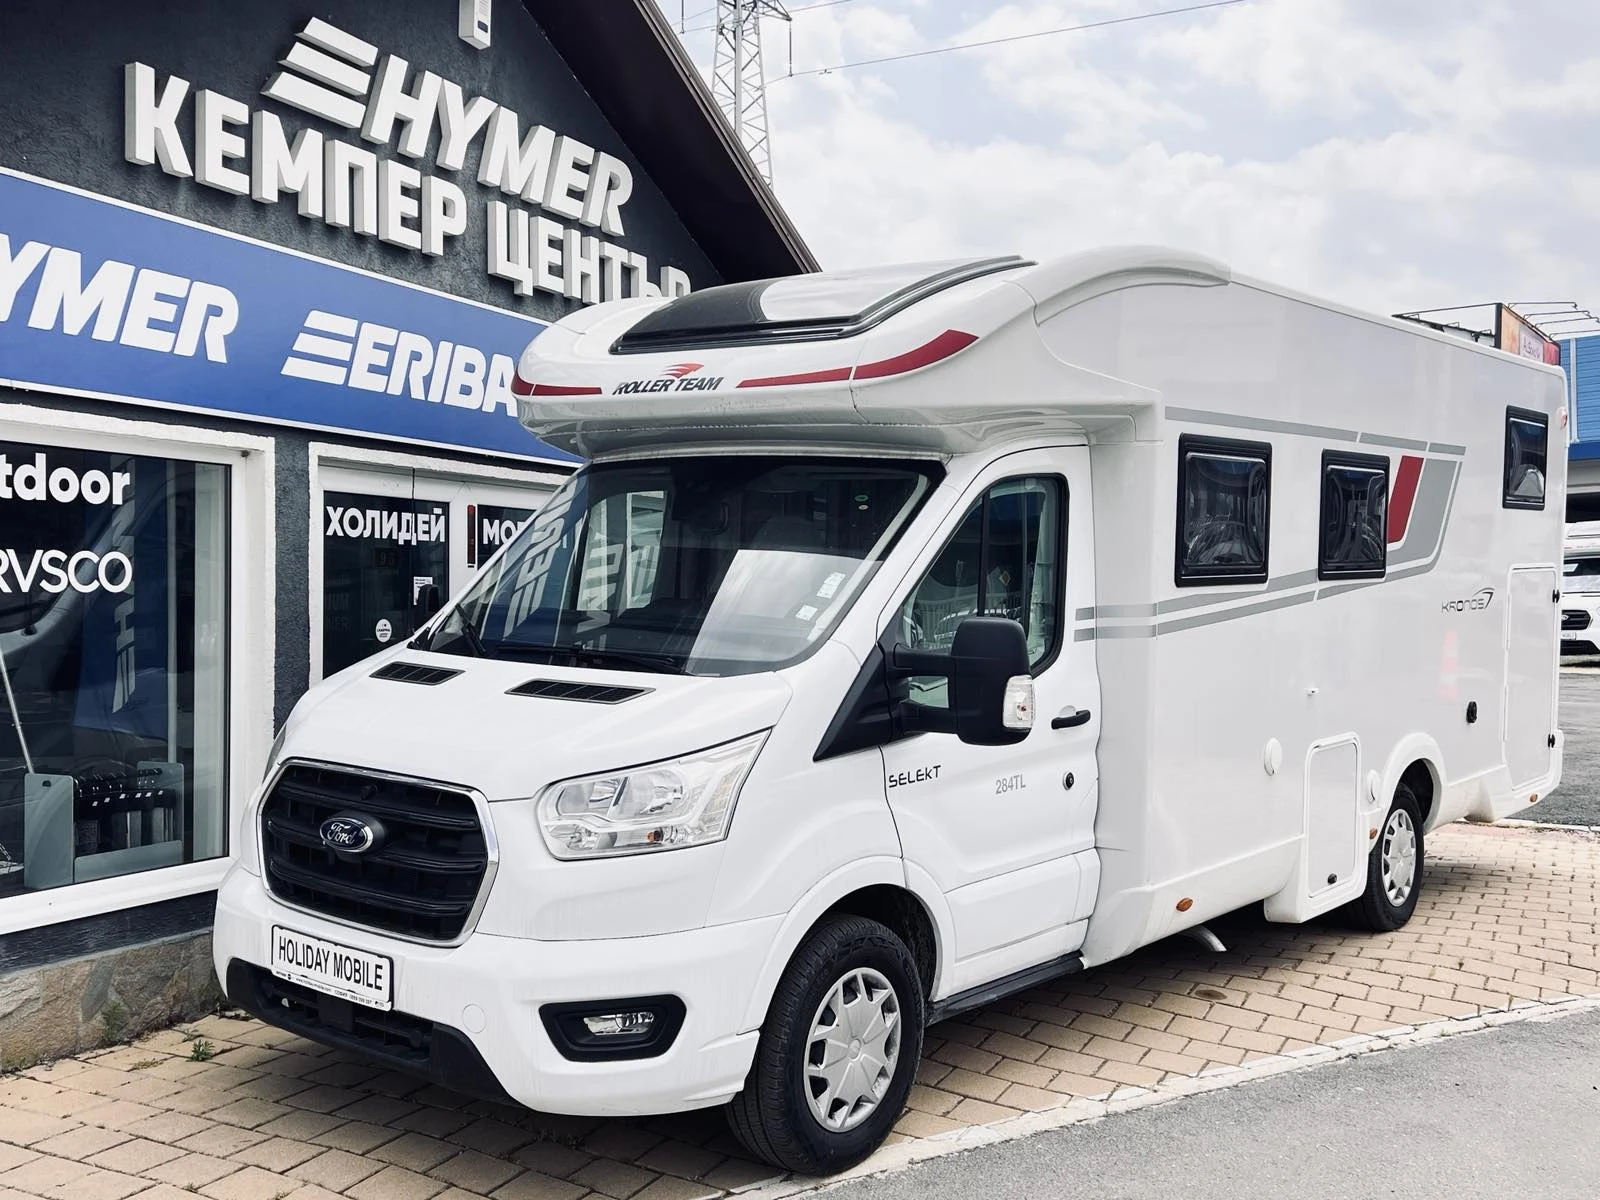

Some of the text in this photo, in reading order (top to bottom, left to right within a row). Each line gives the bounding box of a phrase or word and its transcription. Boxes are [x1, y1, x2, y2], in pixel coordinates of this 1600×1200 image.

[124, 61, 467, 257] КЕМПЕР
[361, 54, 633, 236] HYMER
[347, 322, 518, 418] ERIBA
[612, 377, 724, 395] ROLLER TEAM
[326, 506, 526, 546] ХОЛИДЕЙ МО
[889, 765, 941, 788] SELEKT
[995, 774, 1026, 795] 284TL
[327, 822, 357, 844] Ford
[279, 936, 330, 974] HOLIDAY
[333, 951, 383, 990] MOBILE
